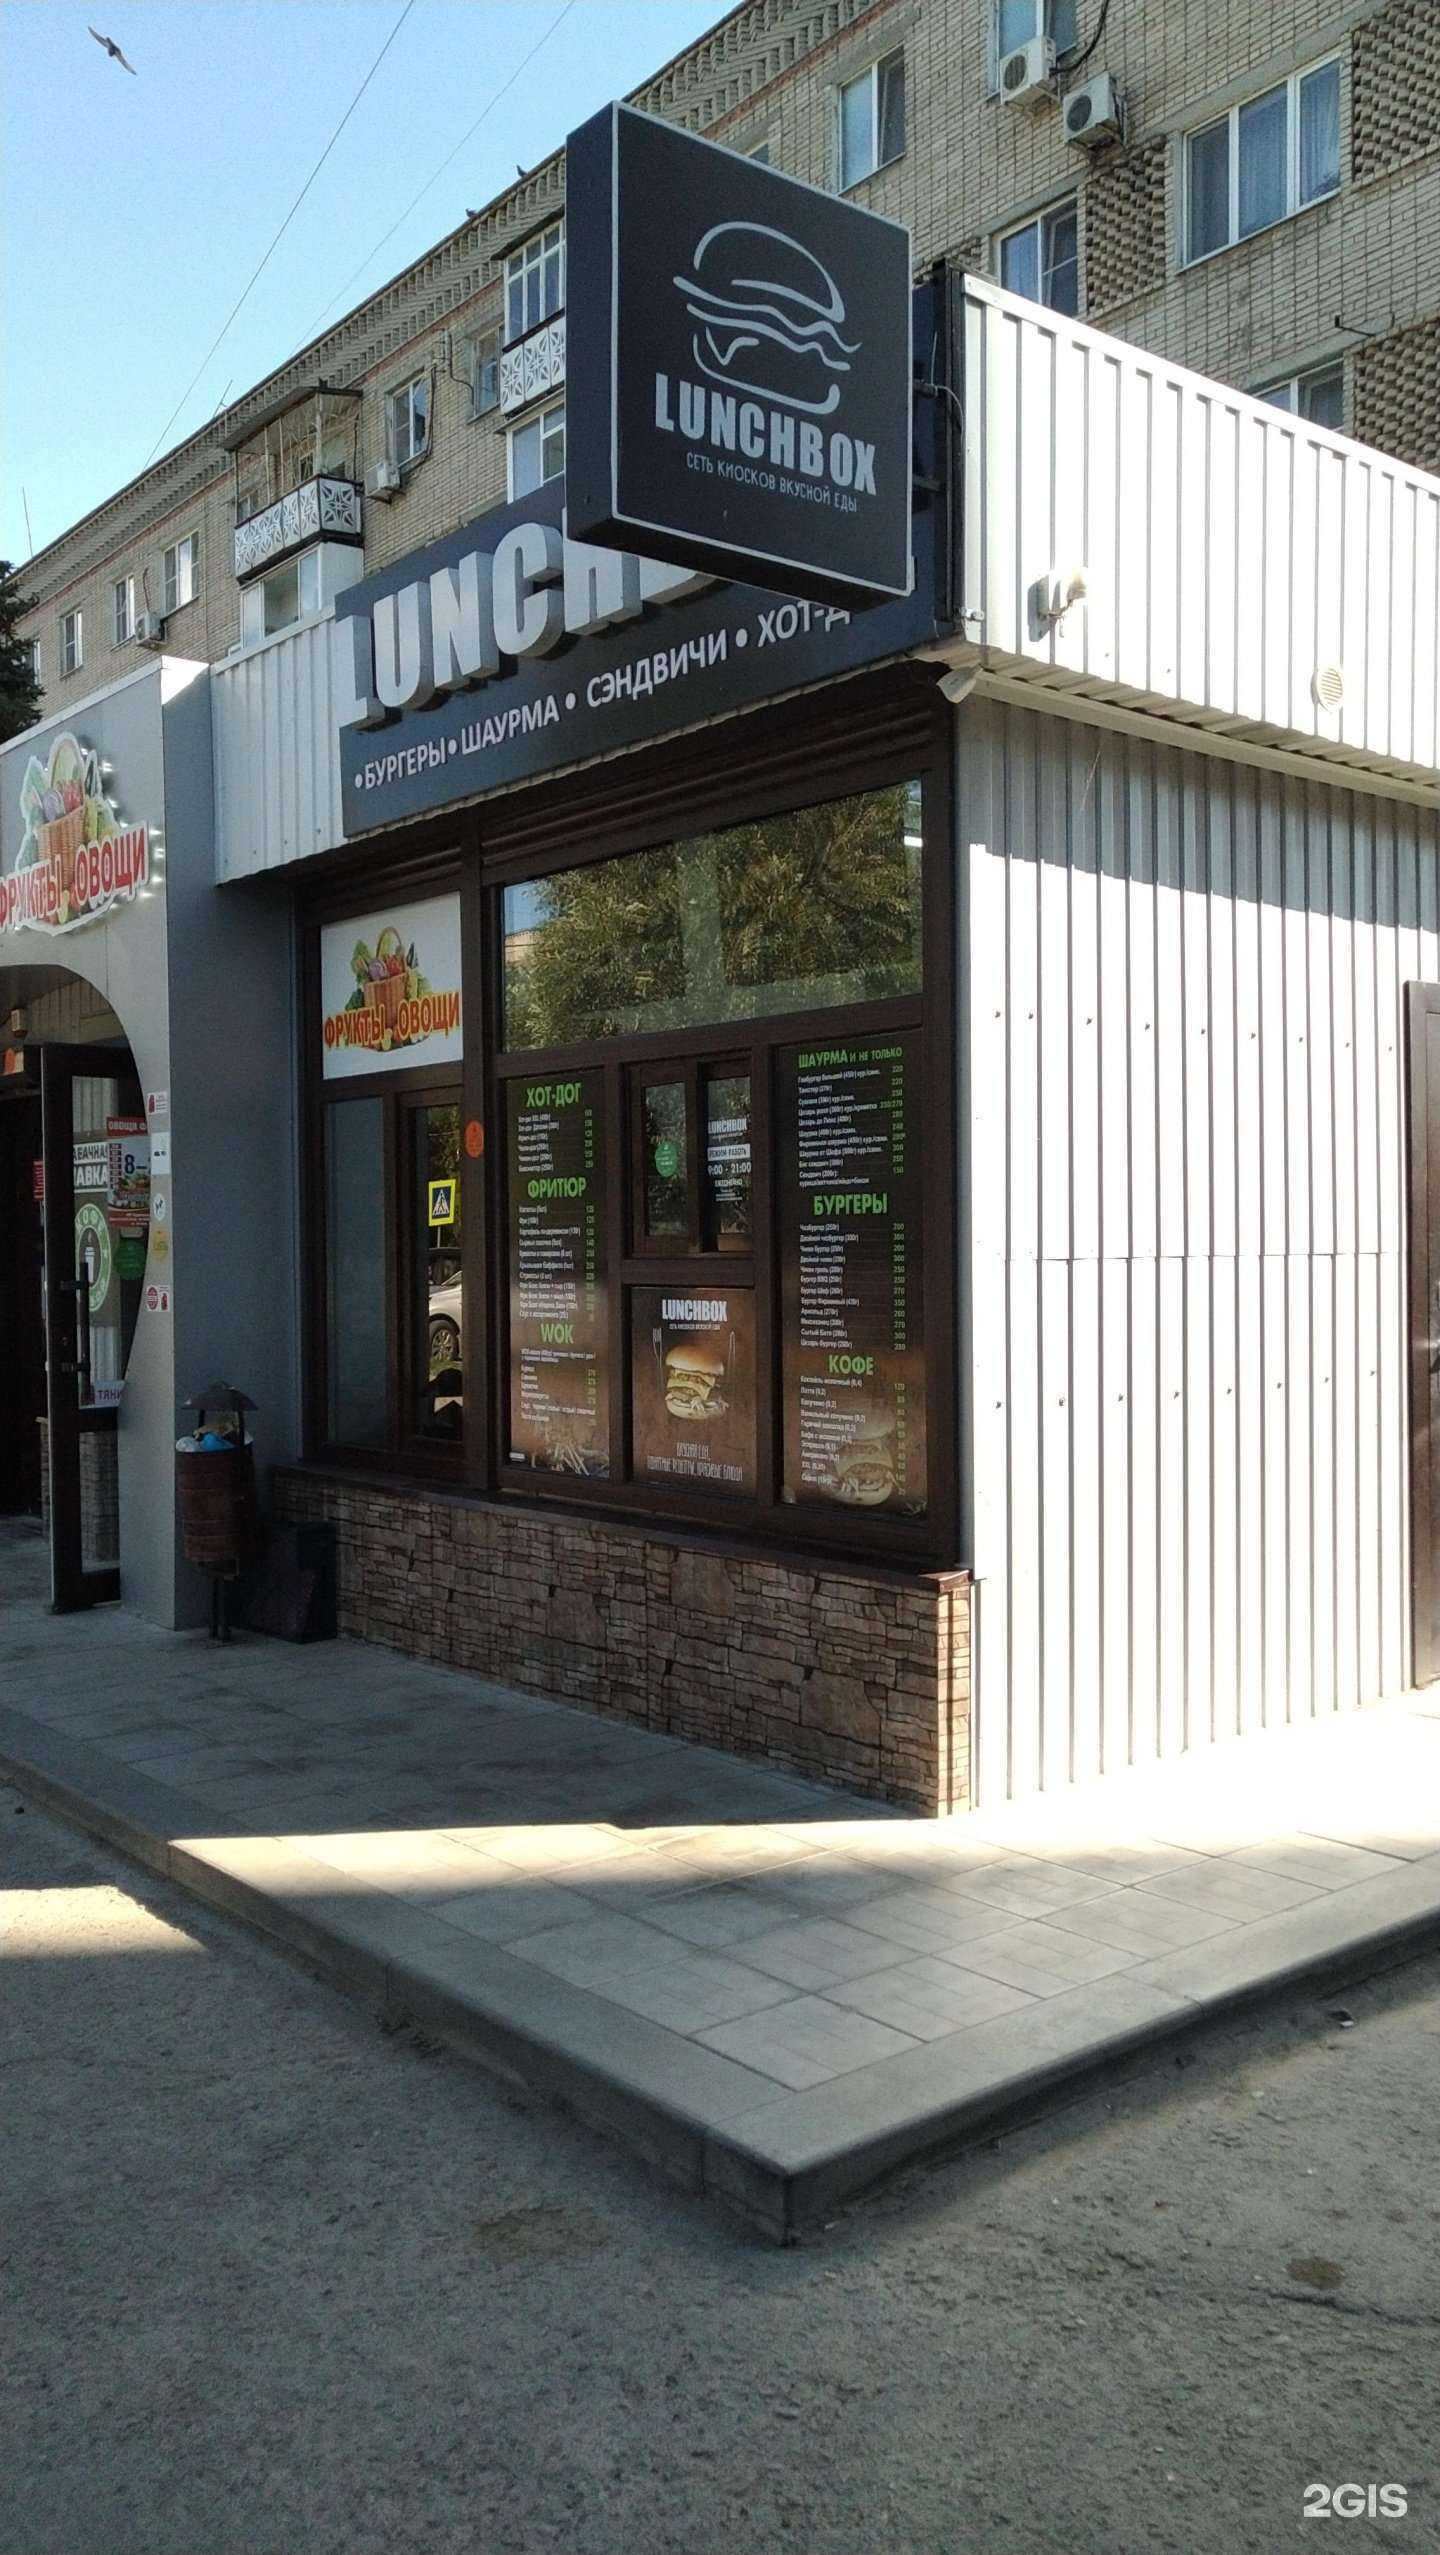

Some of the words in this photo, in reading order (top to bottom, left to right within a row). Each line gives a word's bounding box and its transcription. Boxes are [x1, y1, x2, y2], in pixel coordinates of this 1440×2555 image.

[655, 372, 877, 496] LUNCHBOX
[686, 452, 714, 473] СЕТЬ
[717, 460, 776, 490] КИОСКОВ
[779, 477, 831, 505] ВКУСНОЙ
[834, 492, 857, 513] ЕДЫ
[365, 739, 445, 790] БУРГЕРЫ
[461, 692, 559, 756] ШАУРМА
[586, 629, 727, 709] СЭНДВИЧИ
[75, 828, 145, 902] ОВОЩИ
[324, 1004, 386, 1048] ФРУКТЫ
[398, 992, 460, 1038] ОВОЩИ
[798, 1049, 848, 1068] ШАУРМА
[871, 1047, 902, 1060] ТОЛЬКО
[526, 1082, 581, 1107] ХОТ-ДОГ
[708, 1117, 748, 1134] LUNCHBOX
[731, 1162, 751, 1174] 21:00
[528, 1177, 586, 1198] ФРИТЮР
[813, 1193, 888, 1215] БУРГЕРЫ
[662, 1299, 728, 1322] LUNCHBOX
[540, 1323, 574, 1344] WOK
[828, 1355, 874, 1375] КОФЕ
